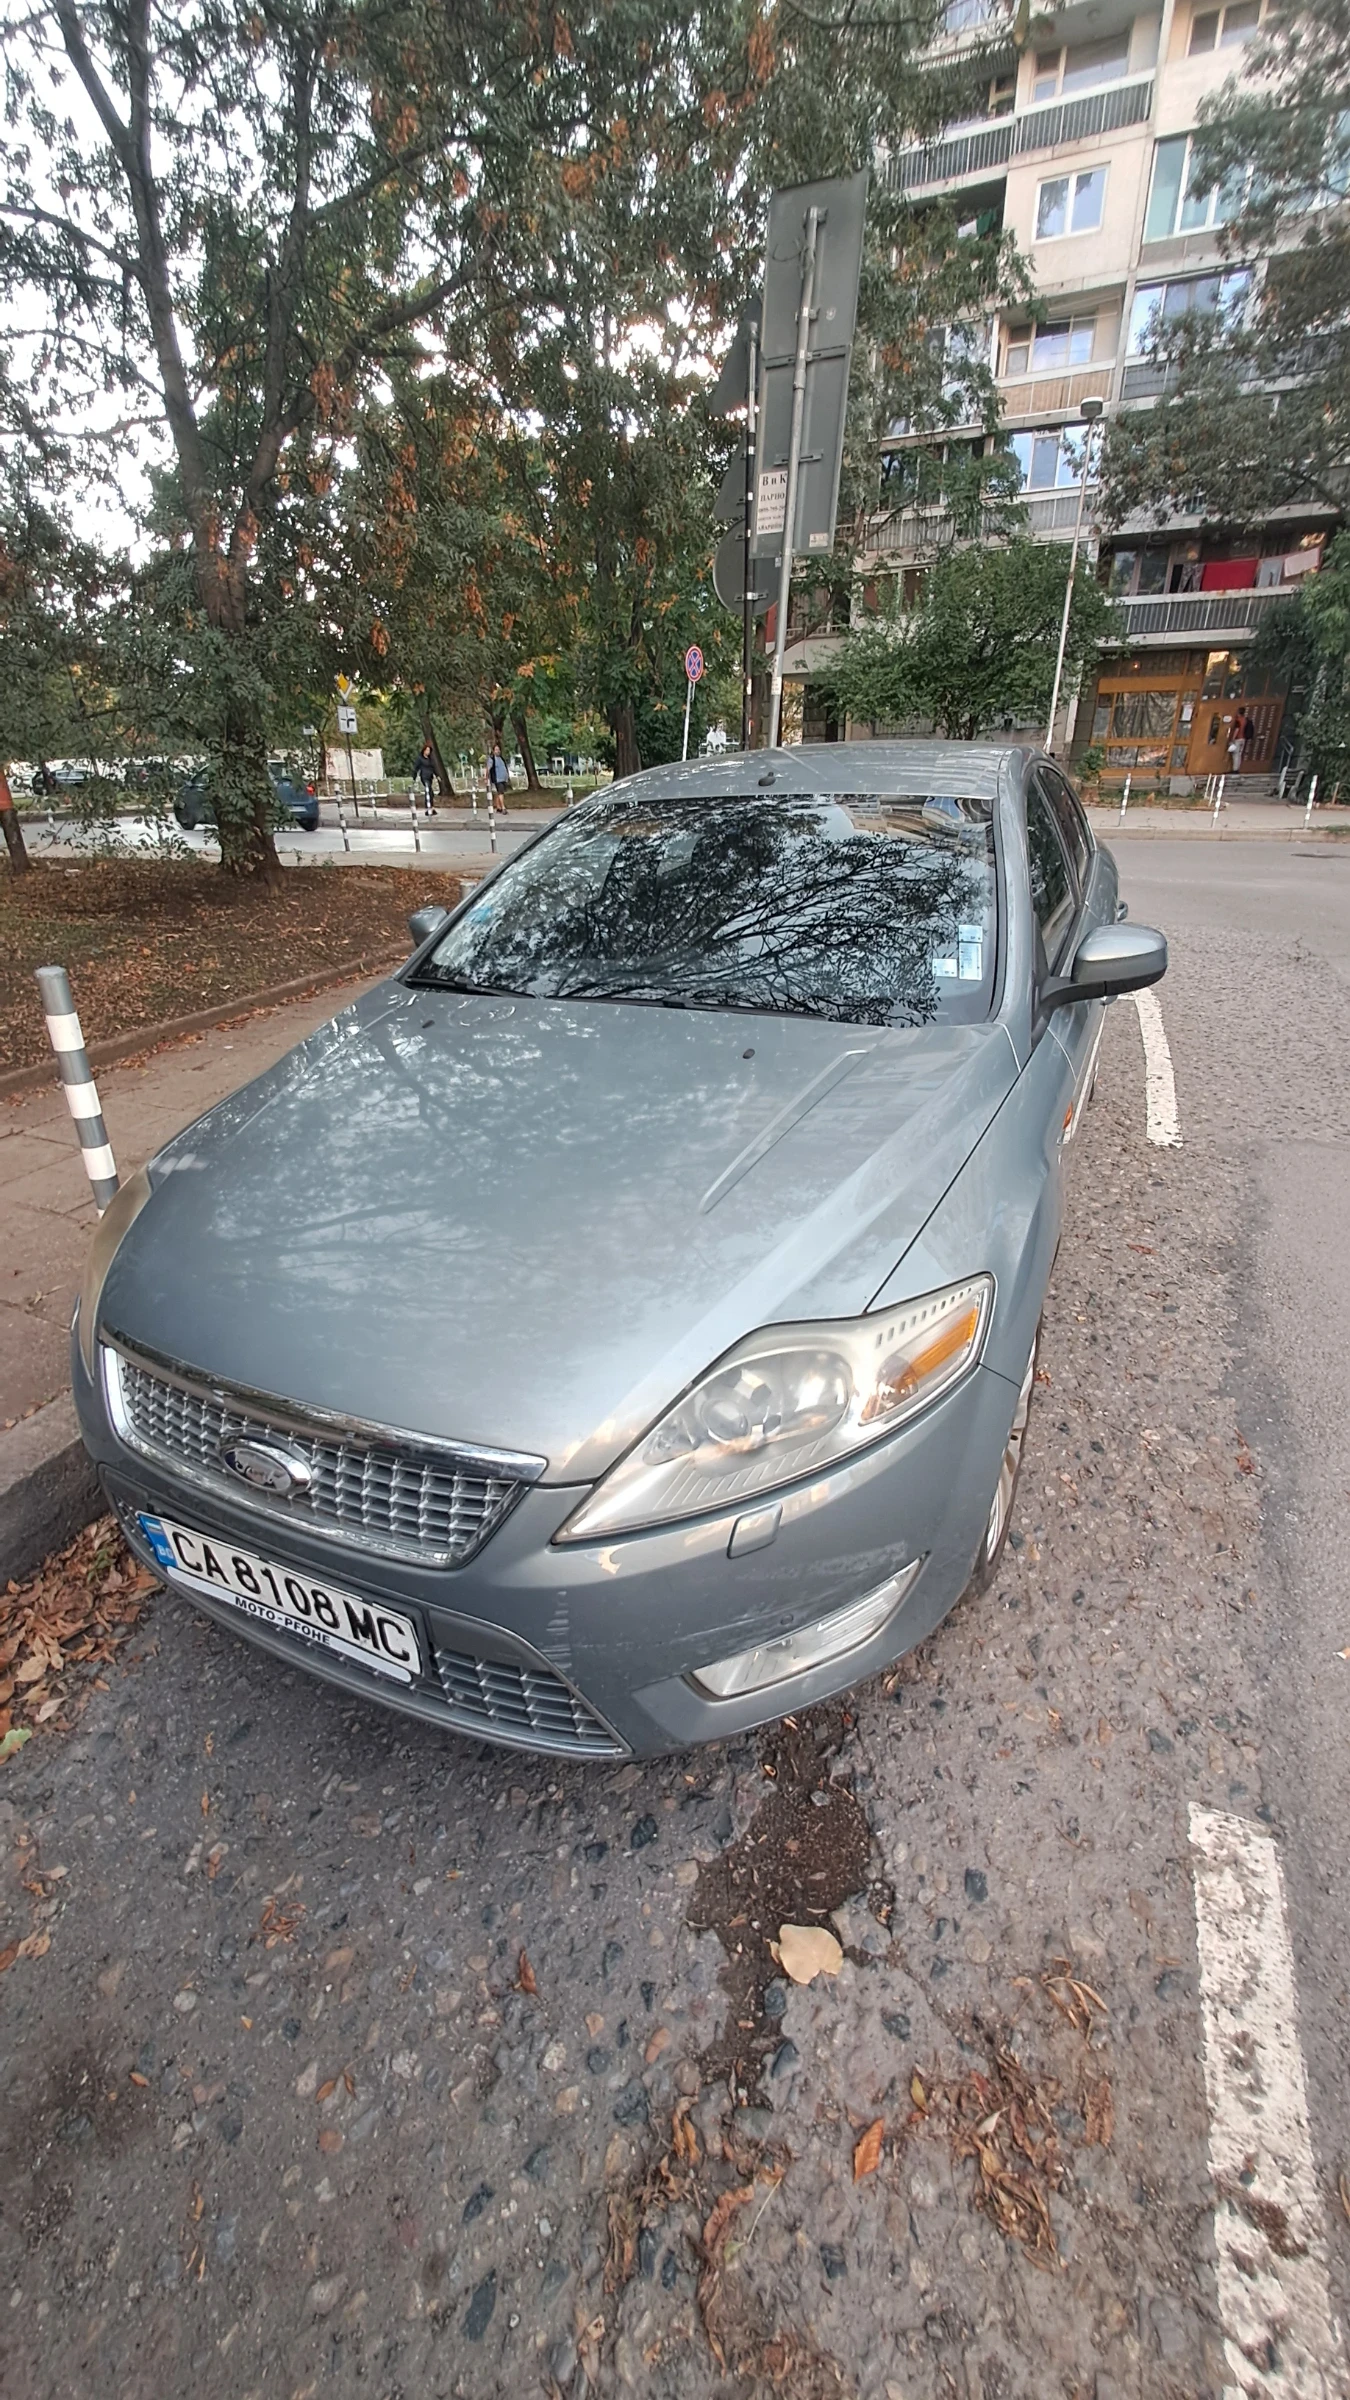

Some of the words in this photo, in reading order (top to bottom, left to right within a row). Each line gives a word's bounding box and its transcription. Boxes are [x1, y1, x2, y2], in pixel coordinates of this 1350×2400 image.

[172, 1531, 230, 1584] CA
[232, 1555, 341, 1629] 8108
[343, 1600, 411, 1661] MC
[235, 1595, 331, 1645] MOTO-PFOHE
